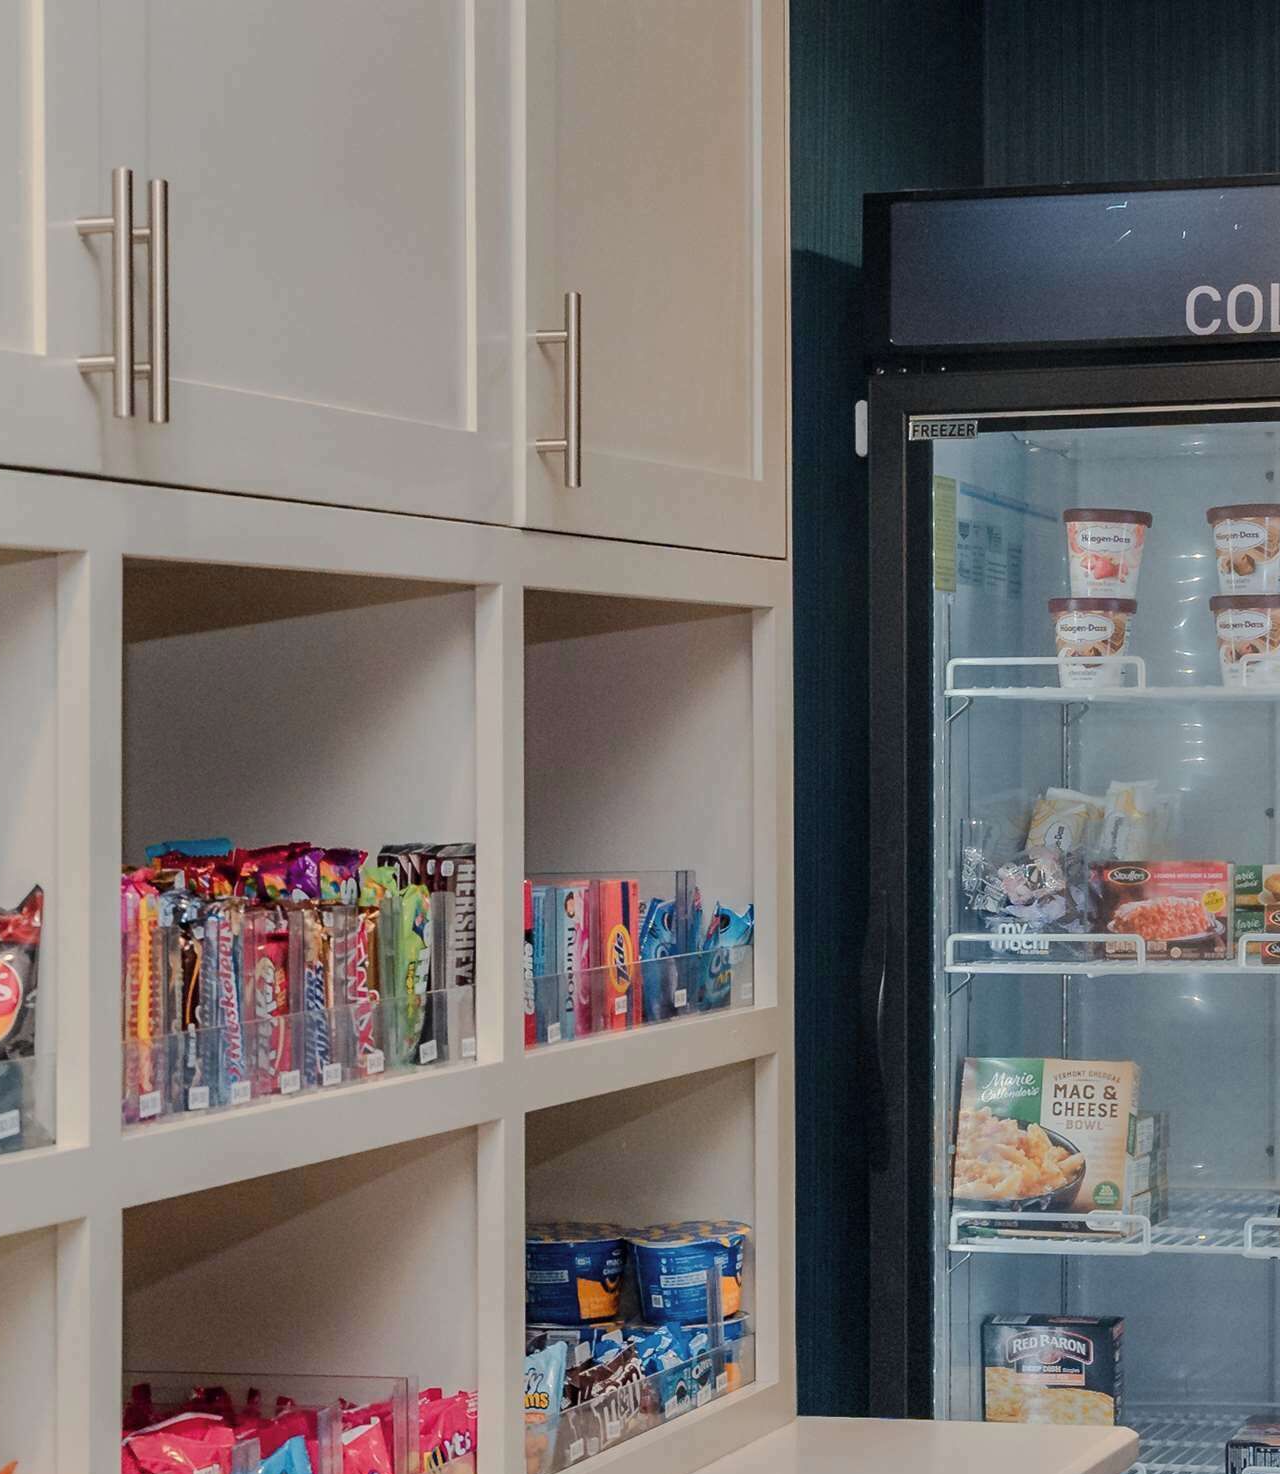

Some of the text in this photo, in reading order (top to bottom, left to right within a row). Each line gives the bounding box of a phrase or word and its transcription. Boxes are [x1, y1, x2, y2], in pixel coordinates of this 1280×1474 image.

[912, 423, 975, 438] FREEZER
[615, 932, 630, 985] Tide
[983, 1072, 1036, 1089] Marie
[1053, 1084, 1118, 1100] MAC &
[1052, 1101, 1119, 1118] CHEESE
[1065, 1120, 1104, 1131] BOWL
[1012, 1334, 1087, 1356] RED BARON
